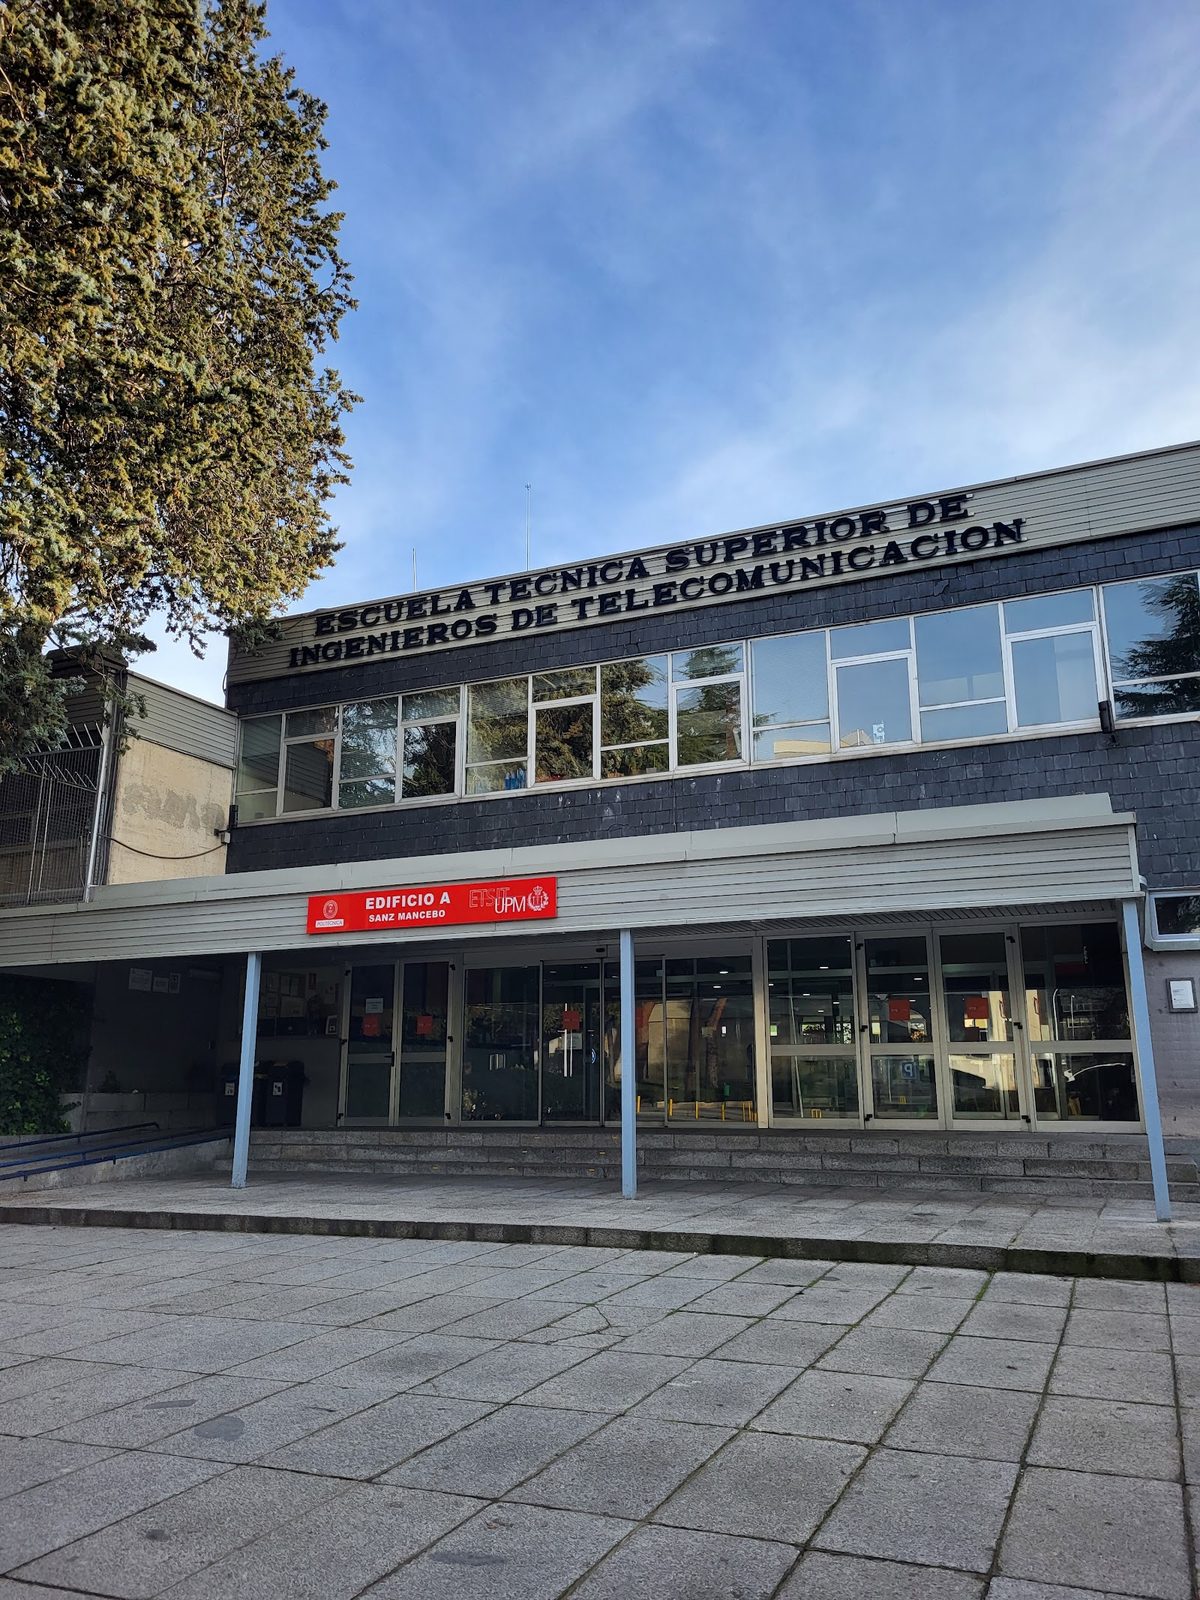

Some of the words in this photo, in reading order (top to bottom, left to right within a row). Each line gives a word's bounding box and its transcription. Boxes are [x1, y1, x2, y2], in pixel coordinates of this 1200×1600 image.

[315, 590, 474, 636] ESCUELA
[485, 556, 649, 605] TECNICA
[666, 510, 889, 572] SUPERIOR
[907, 493, 974, 528] DE
[289, 613, 498, 668] INGENIEROS
[511, 601, 558, 631] DE
[571, 517, 1027, 620] TELECOMUNICACION
[365, 893, 434, 910] EDIFICIO
[439, 891, 451, 904] A
[469, 886, 510, 908] ETSIT
[494, 895, 526, 914] UPM
[368, 912, 395, 923] SANZ
[397, 909, 446, 921] MANCEBO
